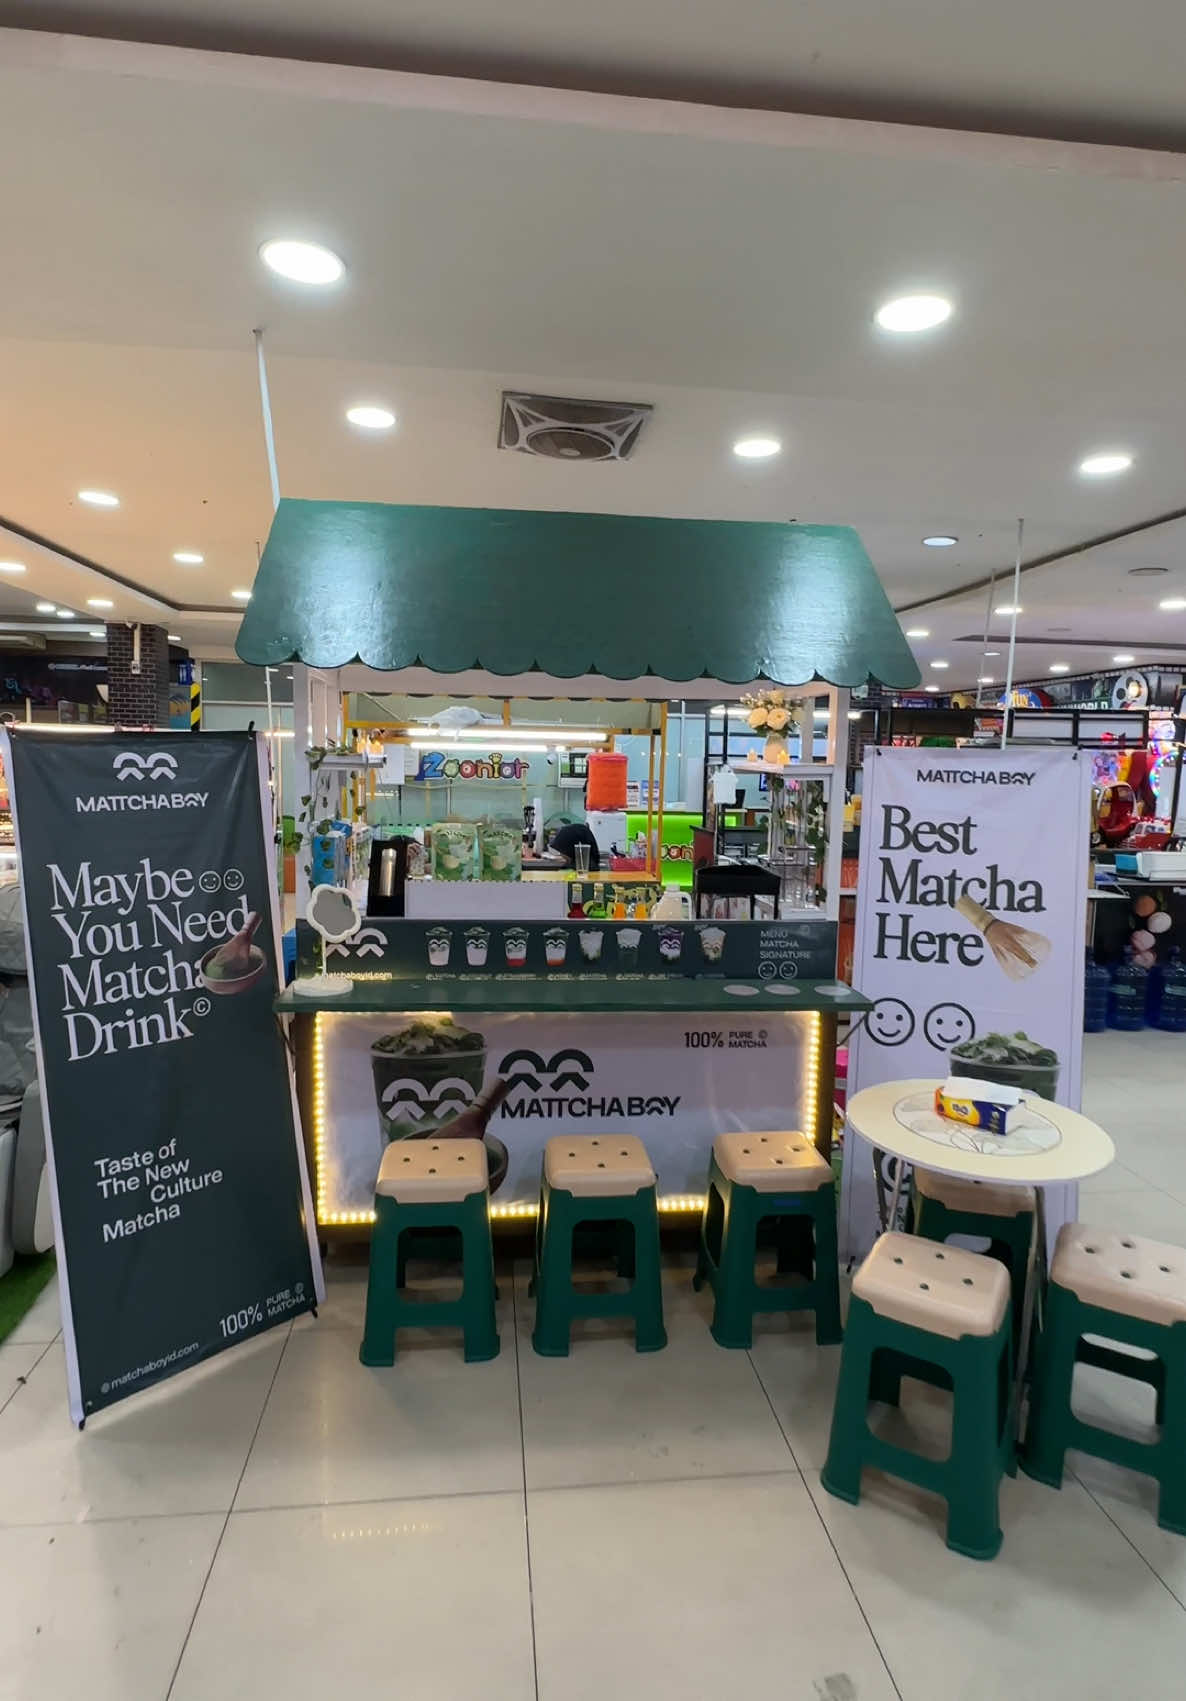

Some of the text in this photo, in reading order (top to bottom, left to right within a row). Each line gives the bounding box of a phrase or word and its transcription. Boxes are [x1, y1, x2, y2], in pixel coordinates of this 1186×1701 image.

[879, 804, 978, 856] Best
[46, 858, 195, 915] Maybe
[876, 857, 1047, 913] Matcha
[51, 894, 249, 959] You Need
[760, 940, 799, 948] MATCHA
[873, 912, 984, 968] Here
[760, 951, 811, 960] SIGNATURE
[684, 1031, 724, 1048] 100%
[729, 1031, 753, 1039] PURE
[728, 1040, 767, 1048] MATCHA
[94, 1138, 176, 1178] Taste of
[97, 1159, 190, 1199] The New
[150, 1169, 223, 1203] Culture
[103, 1203, 180, 1243] Matcha
[219, 1302, 262, 1338] 100%
[266, 1289, 290, 1307] PURE
[267, 1294, 305, 1318] MATCHA
